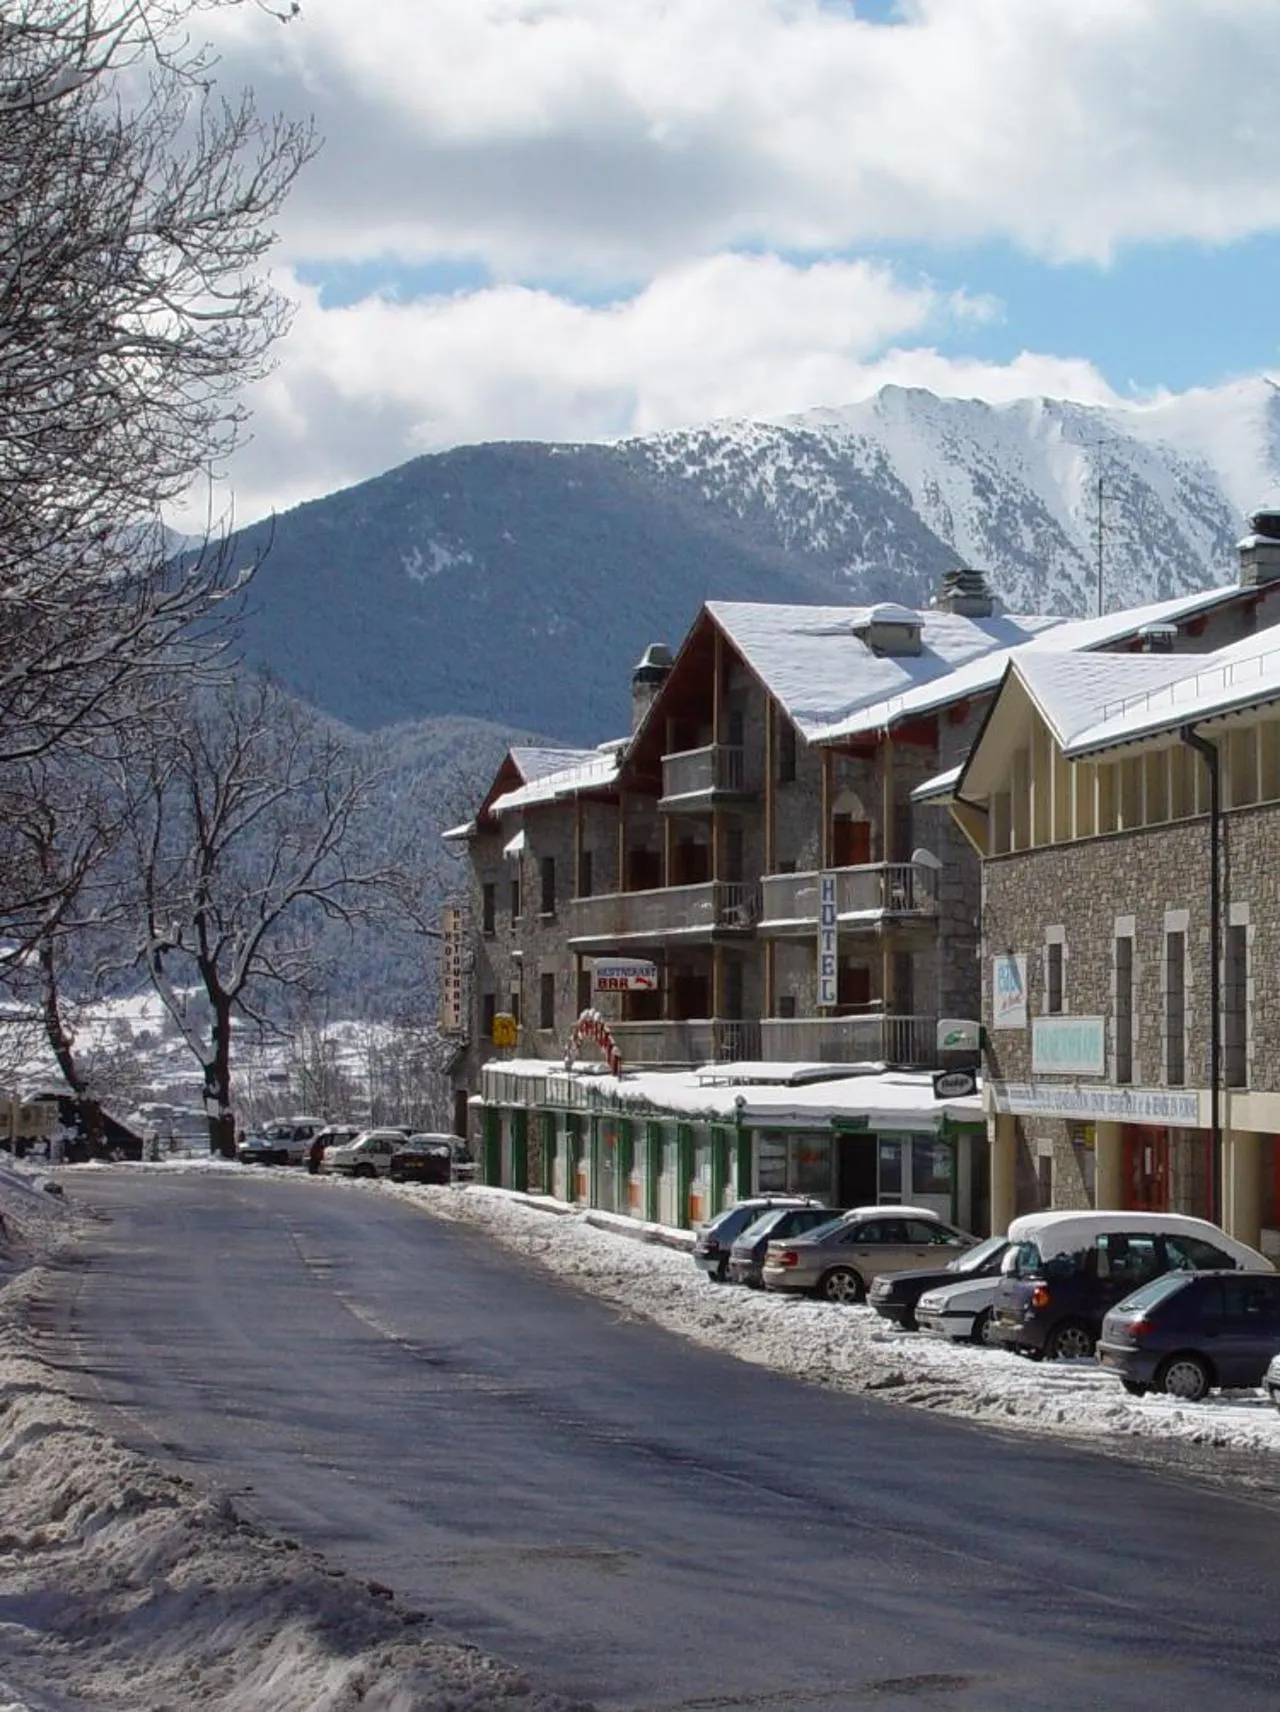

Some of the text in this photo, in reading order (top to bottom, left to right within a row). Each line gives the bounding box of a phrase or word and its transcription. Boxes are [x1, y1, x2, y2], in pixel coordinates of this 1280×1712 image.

[444, 931, 453, 1002] HOTEL
[822, 879, 835, 1001] HOTEL
[598, 978, 629, 990] BAR
